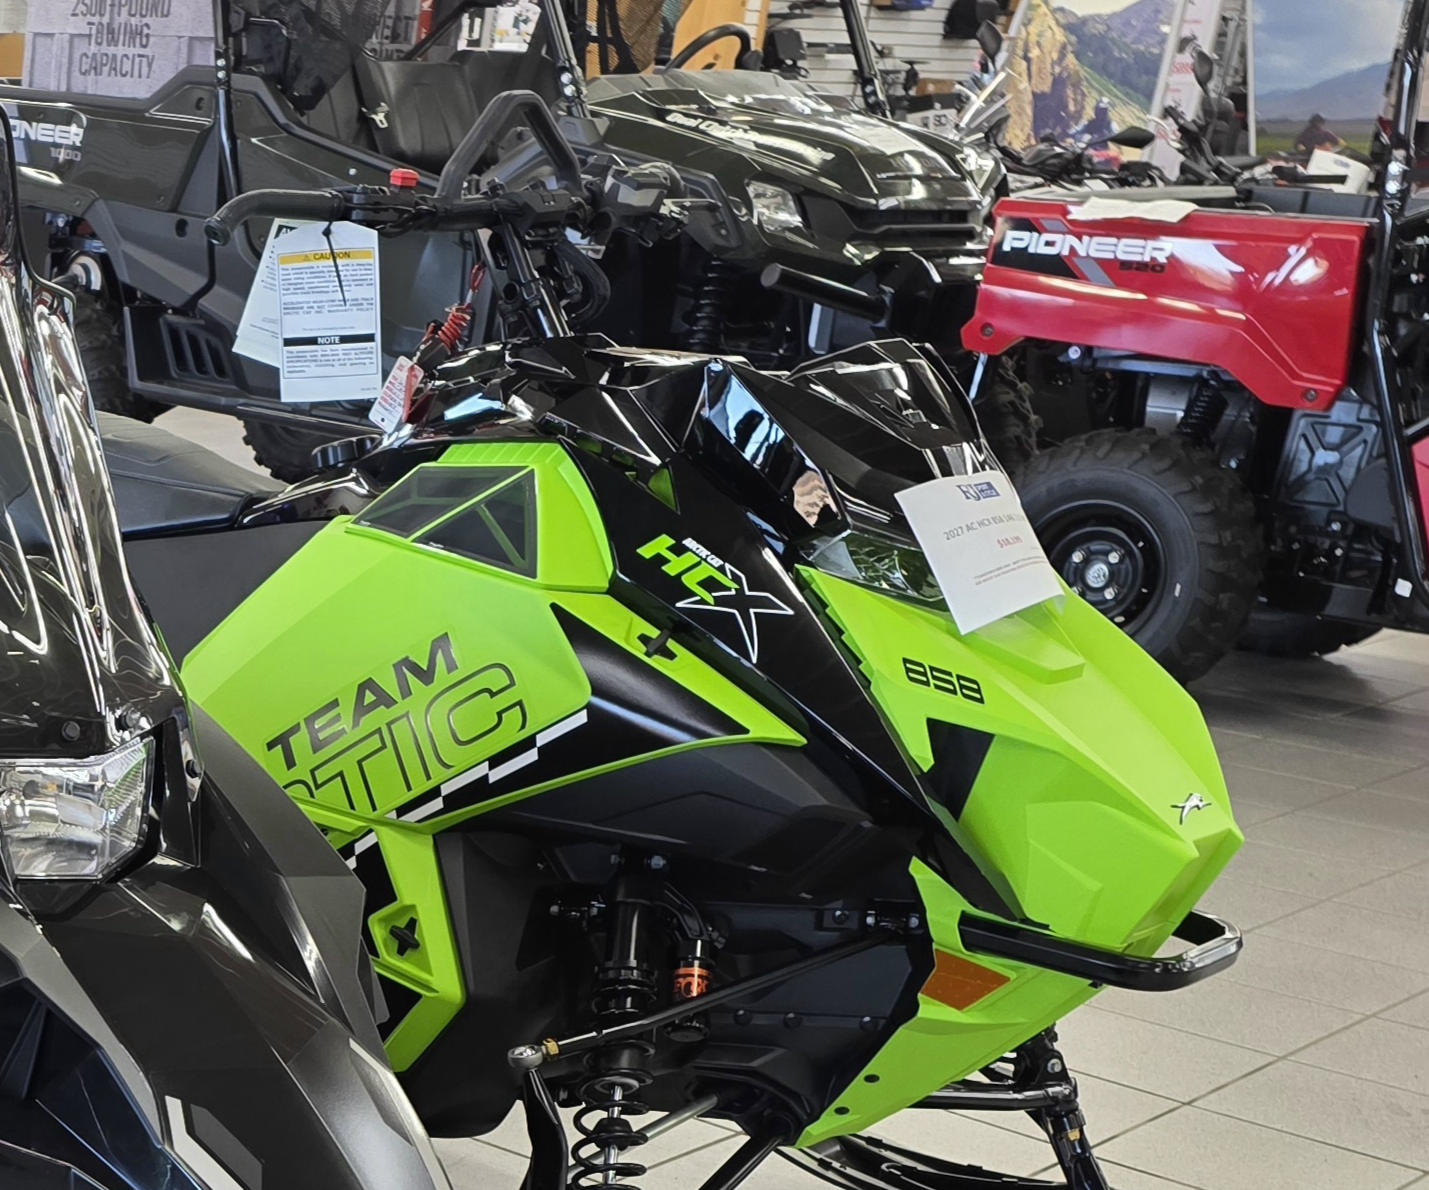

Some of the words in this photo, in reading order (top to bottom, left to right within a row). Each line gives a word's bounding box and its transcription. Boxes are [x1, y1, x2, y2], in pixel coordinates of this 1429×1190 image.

[86, 21, 151, 49] TOWING
[78, 52, 156, 79] CAPACITY
[1001, 229, 1174, 263] PIONEER
[317, 336, 341, 344] NOTE
[943, 525, 966, 541] 2027
[965, 521, 979, 533] AC
[977, 518, 993, 529] HCX
[682, 537, 712, 559] ARCTIC
[636, 533, 795, 664] HCX
[901, 656, 986, 705] 858
[266, 631, 459, 772] TEAM
